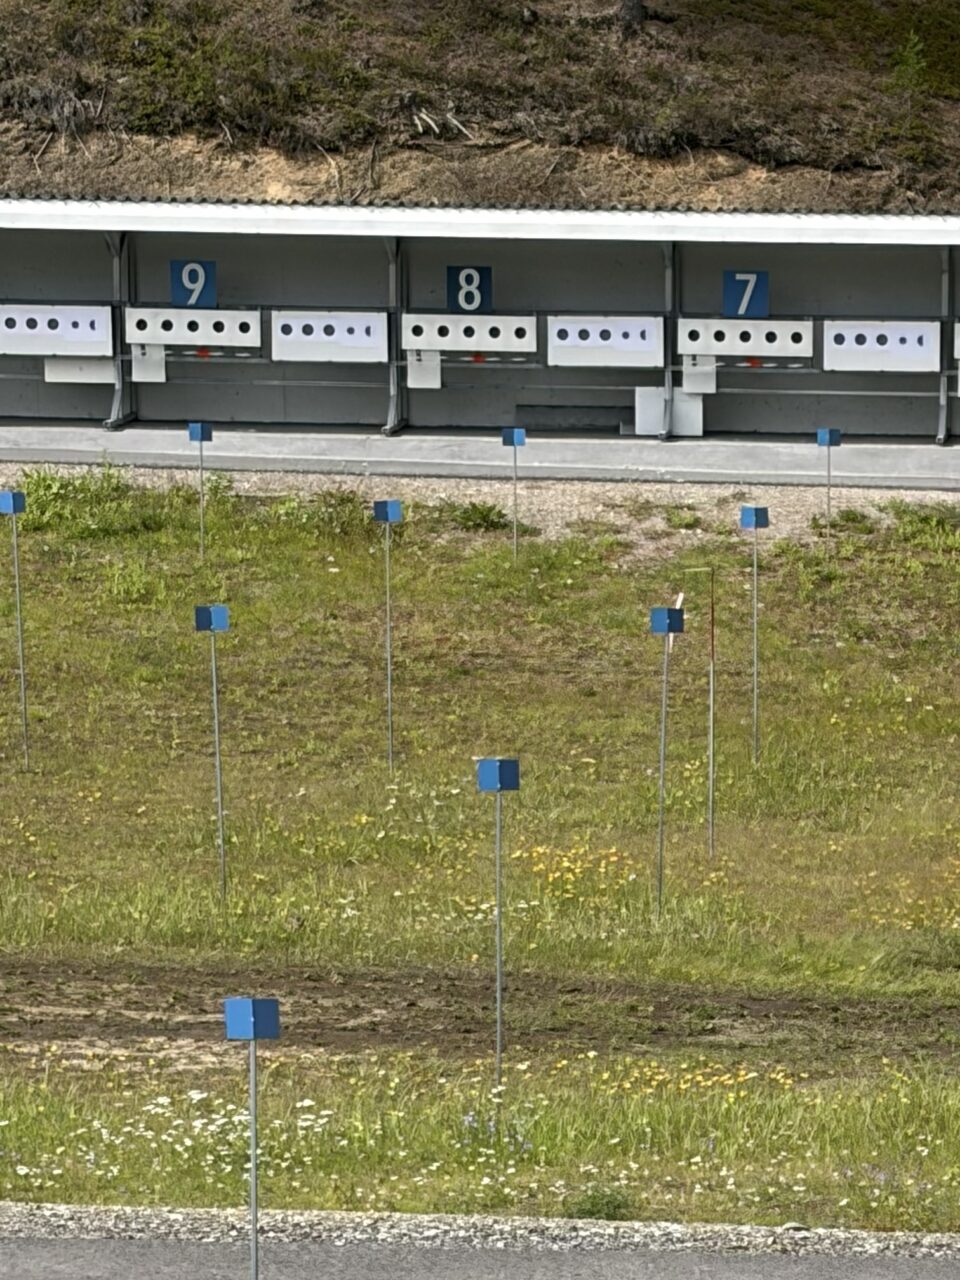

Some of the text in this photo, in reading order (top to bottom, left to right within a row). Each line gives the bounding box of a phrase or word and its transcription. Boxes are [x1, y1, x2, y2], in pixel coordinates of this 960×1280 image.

[181, 262, 206, 306] 9
[457, 267, 482, 311] 8
[735, 272, 757, 315] 7
